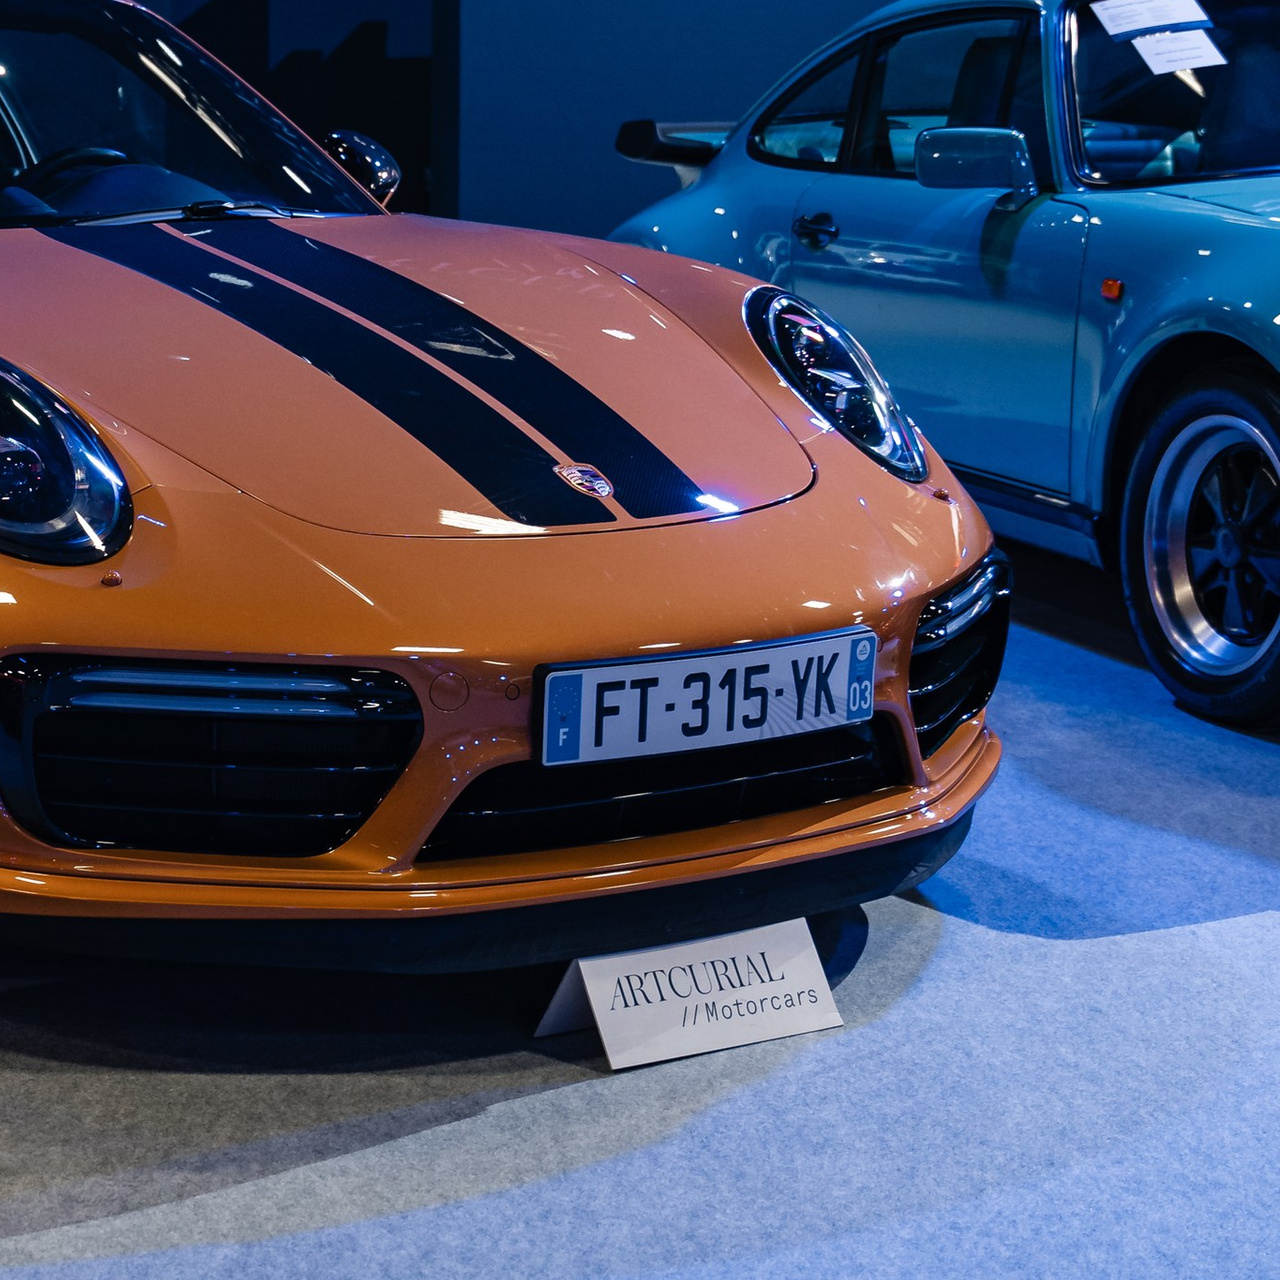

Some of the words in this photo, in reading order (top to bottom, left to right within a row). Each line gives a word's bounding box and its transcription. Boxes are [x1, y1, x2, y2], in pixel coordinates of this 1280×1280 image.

[558, 727, 569, 747] F
[594, 652, 840, 748] FT-315-YK
[849, 680, 872, 712] 03
[609, 951, 785, 1011] ARTCURIAL
[682, 988, 819, 1027] //Motorcars
